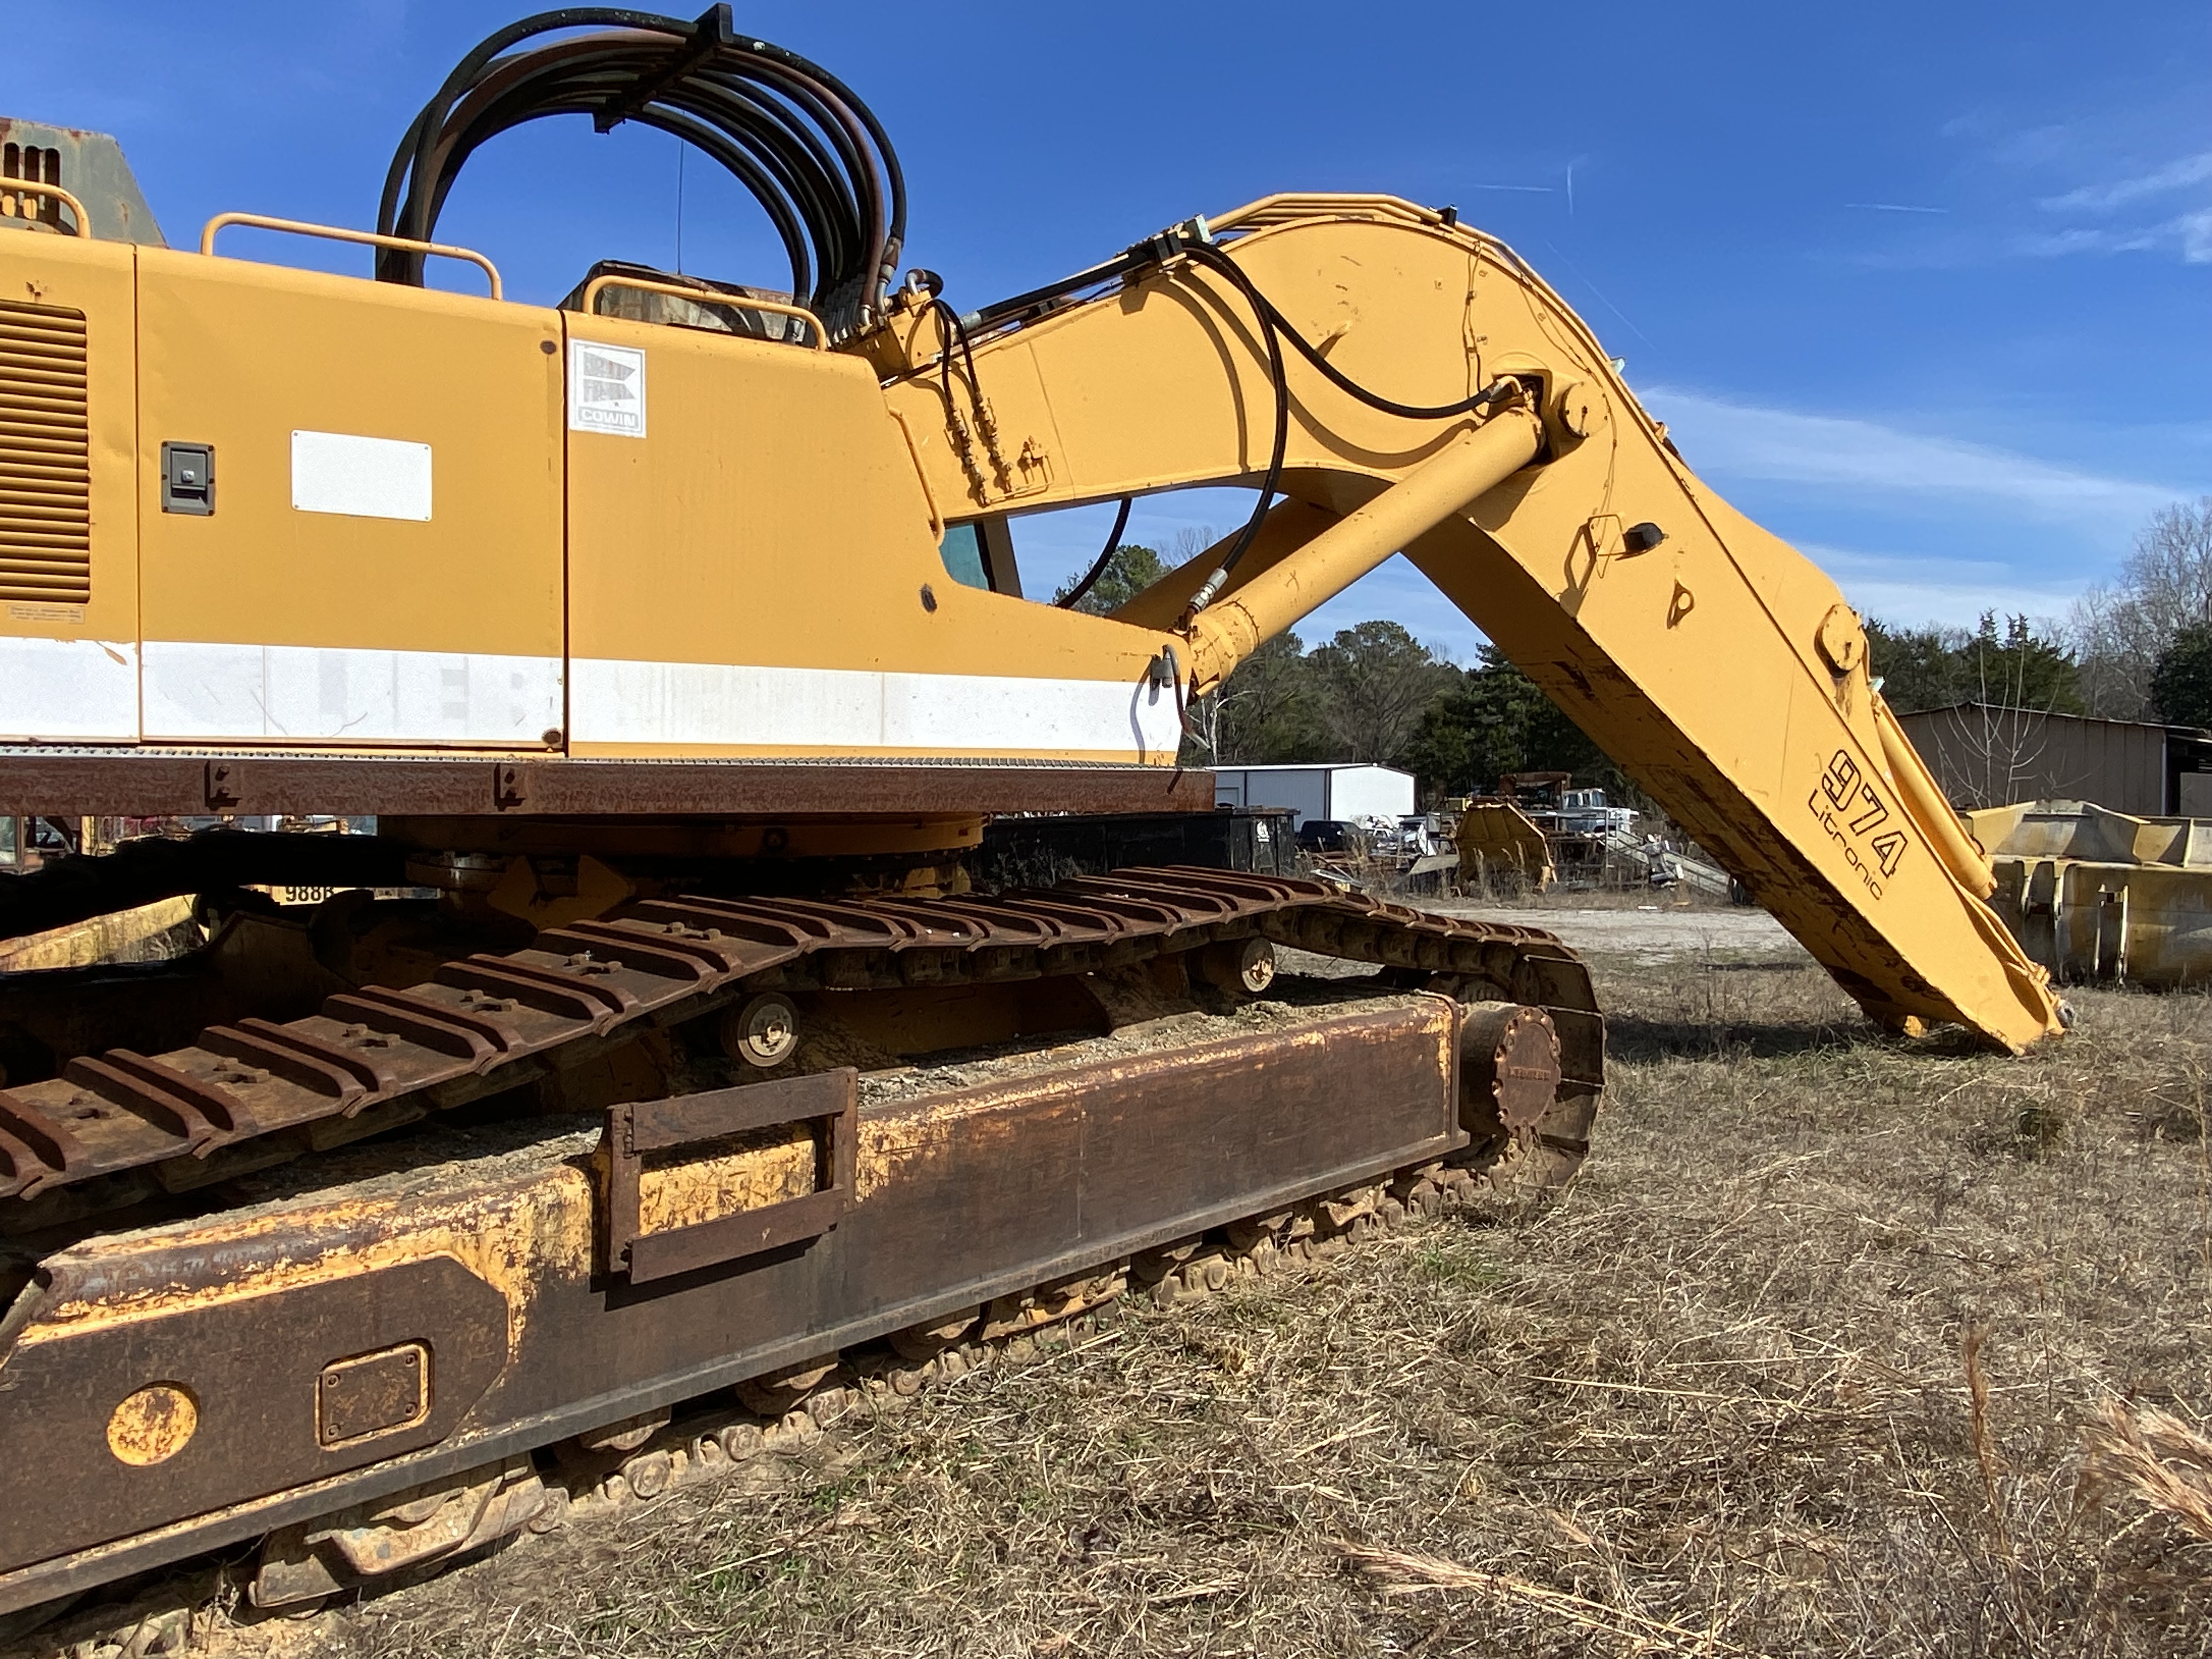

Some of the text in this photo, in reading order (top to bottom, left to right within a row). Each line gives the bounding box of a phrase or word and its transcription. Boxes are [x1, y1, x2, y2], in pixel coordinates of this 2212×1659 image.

[582, 409, 635, 427] COWIN
[1808, 788, 1883, 900] Litronic
[1821, 749, 1908, 879] 974
